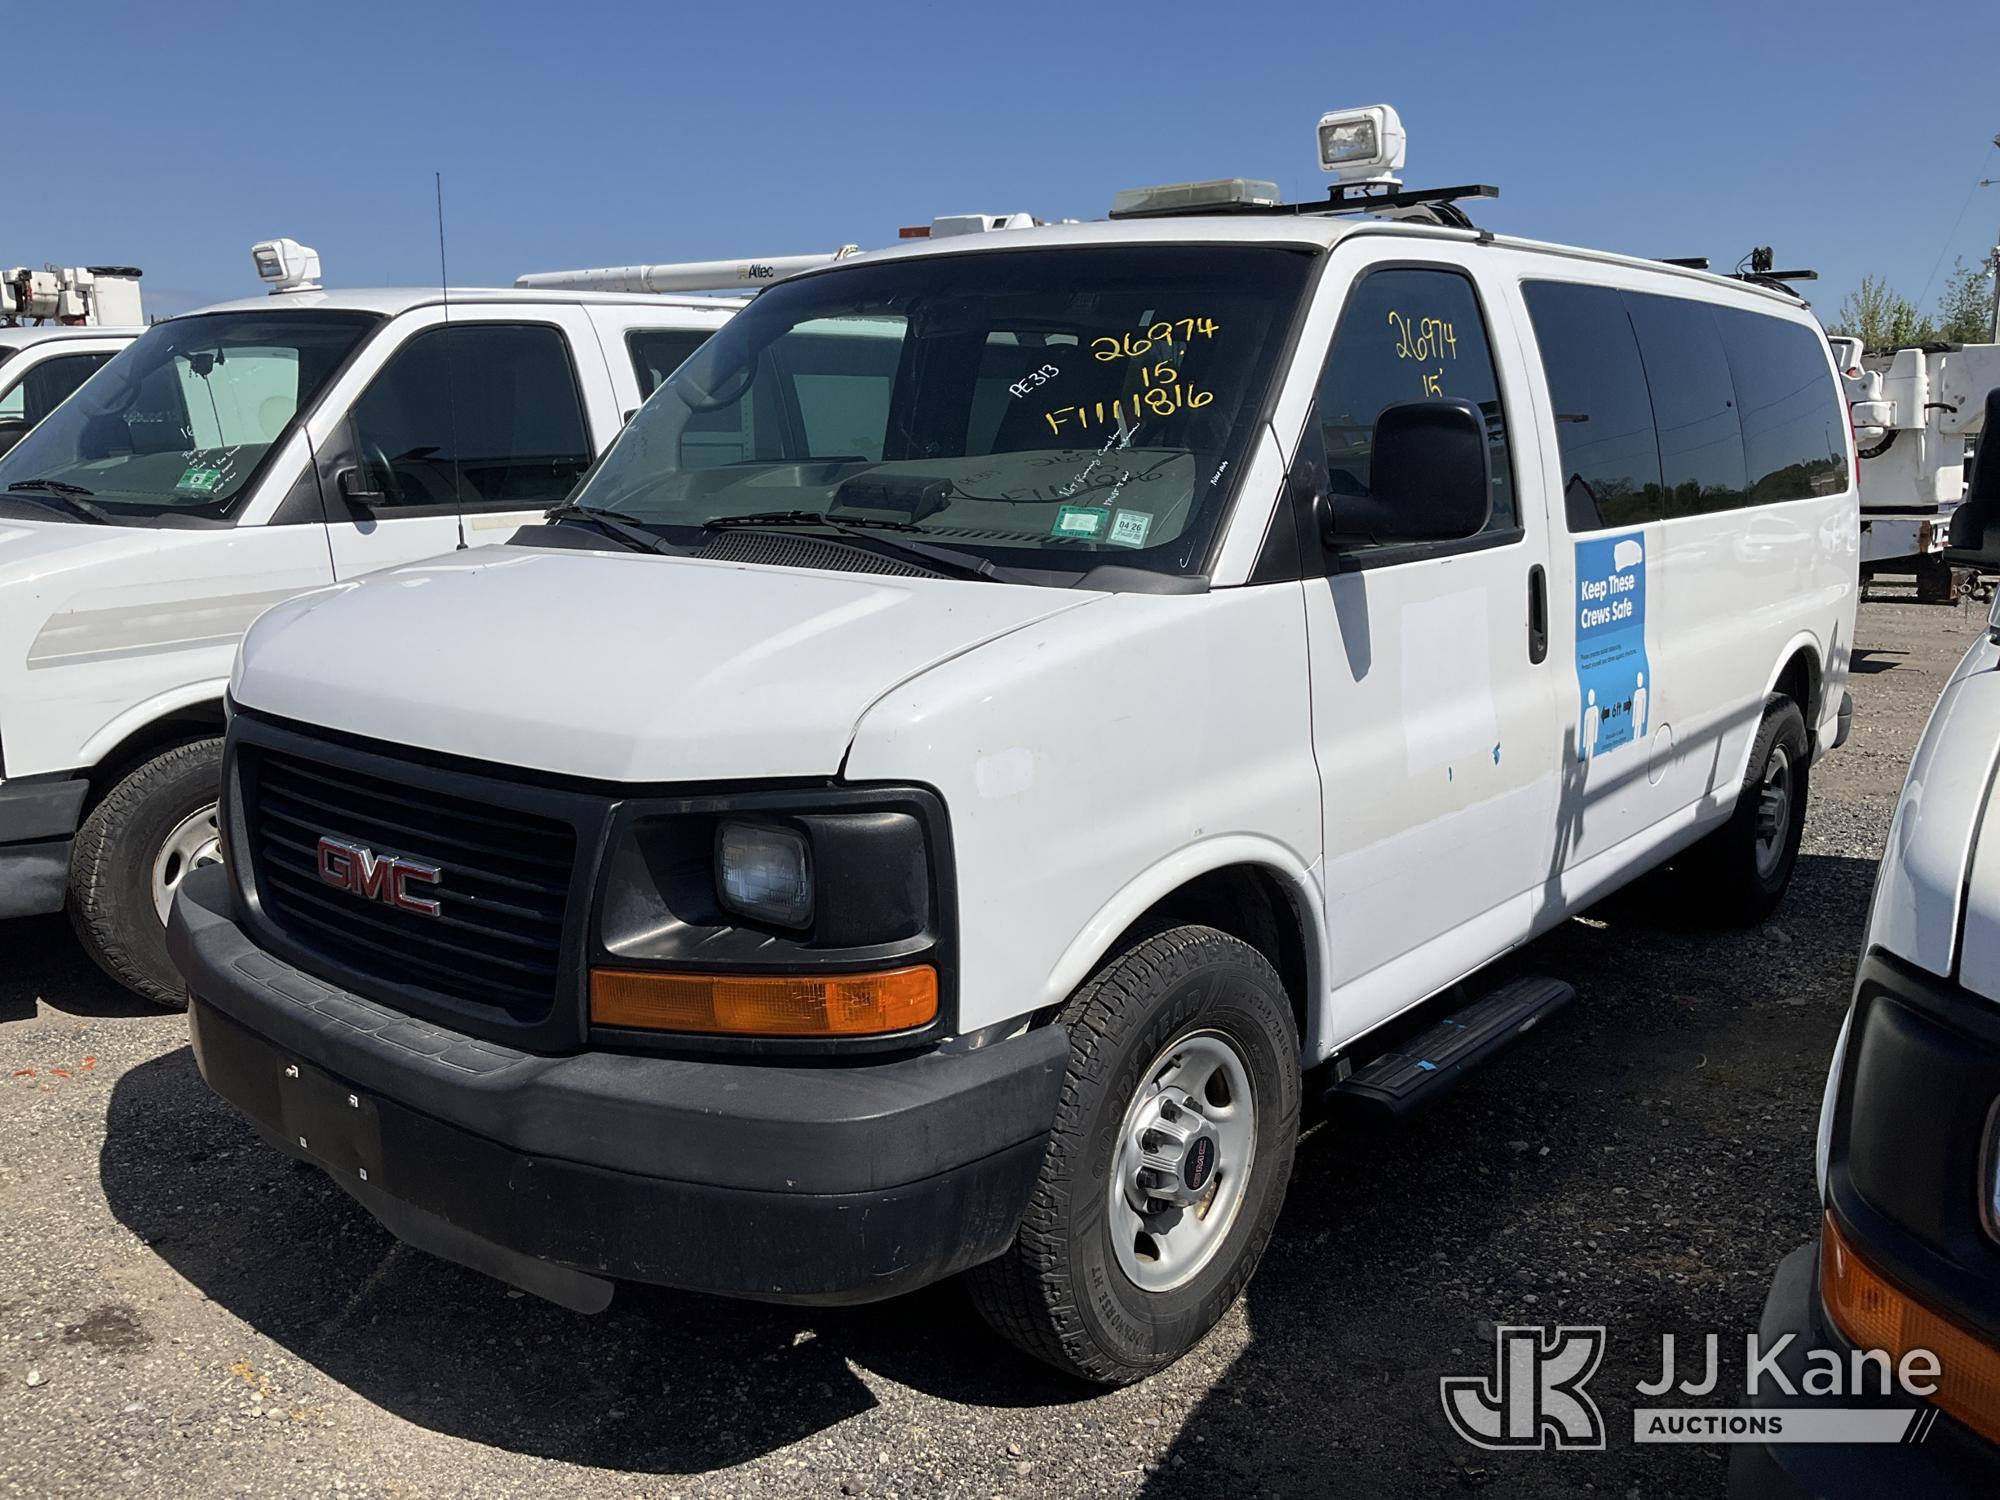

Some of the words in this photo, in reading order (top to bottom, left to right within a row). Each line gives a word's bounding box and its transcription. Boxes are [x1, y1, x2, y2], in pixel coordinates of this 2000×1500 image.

[748, 264, 774, 279] Altec
[1091, 318, 1219, 361] 26974
[1388, 311, 1457, 361] 26974
[1045, 383, 1214, 435] F1111816
[1119, 520, 1129, 530] 04
[1131, 522, 1142, 532] 26
[1581, 580, 1607, 602] Keep
[1608, 574, 1636, 595] These
[1581, 606, 1611, 629] Crews
[1612, 597, 1633, 621] Safe
[1611, 701, 1623, 718] 6ft
[318, 836, 442, 917] GMC
[1193, 1139, 1207, 1188] GMC
